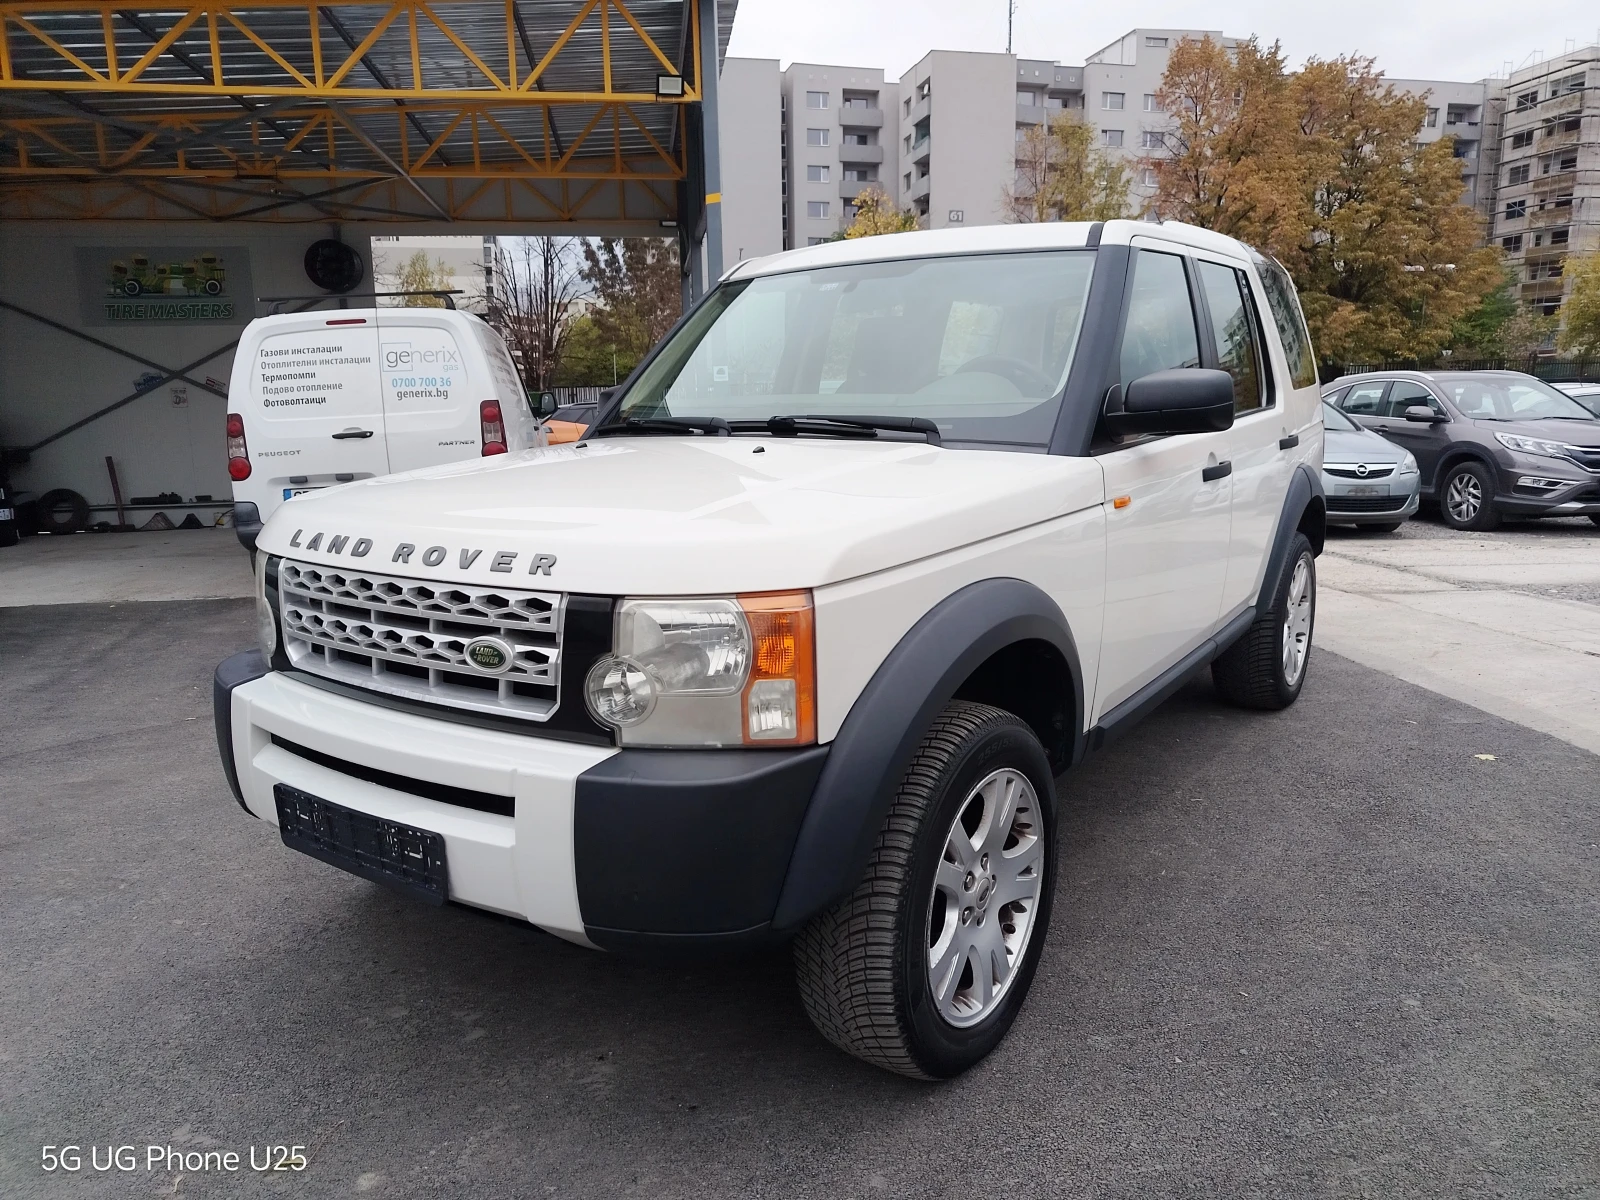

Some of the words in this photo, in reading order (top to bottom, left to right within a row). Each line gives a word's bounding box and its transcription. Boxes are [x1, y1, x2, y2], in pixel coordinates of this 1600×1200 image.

[950, 211, 963, 221] 61
[104, 303, 145, 320] TIRE
[148, 302, 233, 320] MASTERS
[260, 348, 290, 358] Газови
[291, 345, 343, 356] инсталации
[386, 345, 458, 368] generix
[261, 359, 318, 370] Отоплителни
[319, 356, 371, 366] инсталации
[442, 364, 459, 372] gas
[261, 371, 316, 383] Термопомпи
[391, 378, 416, 388] 0700
[418, 377, 437, 387] 700
[439, 377, 452, 387] 36
[262, 385, 295, 396] Подово
[296, 382, 343, 393] отопление
[396, 388, 449, 401] generix.bg
[263, 396, 327, 408] Фотоволтаици
[289, 529, 373, 558] LAND
[391, 542, 558, 577] ROVER
[476, 647, 493, 656] LAND
[477, 654, 499, 664] ROVER
